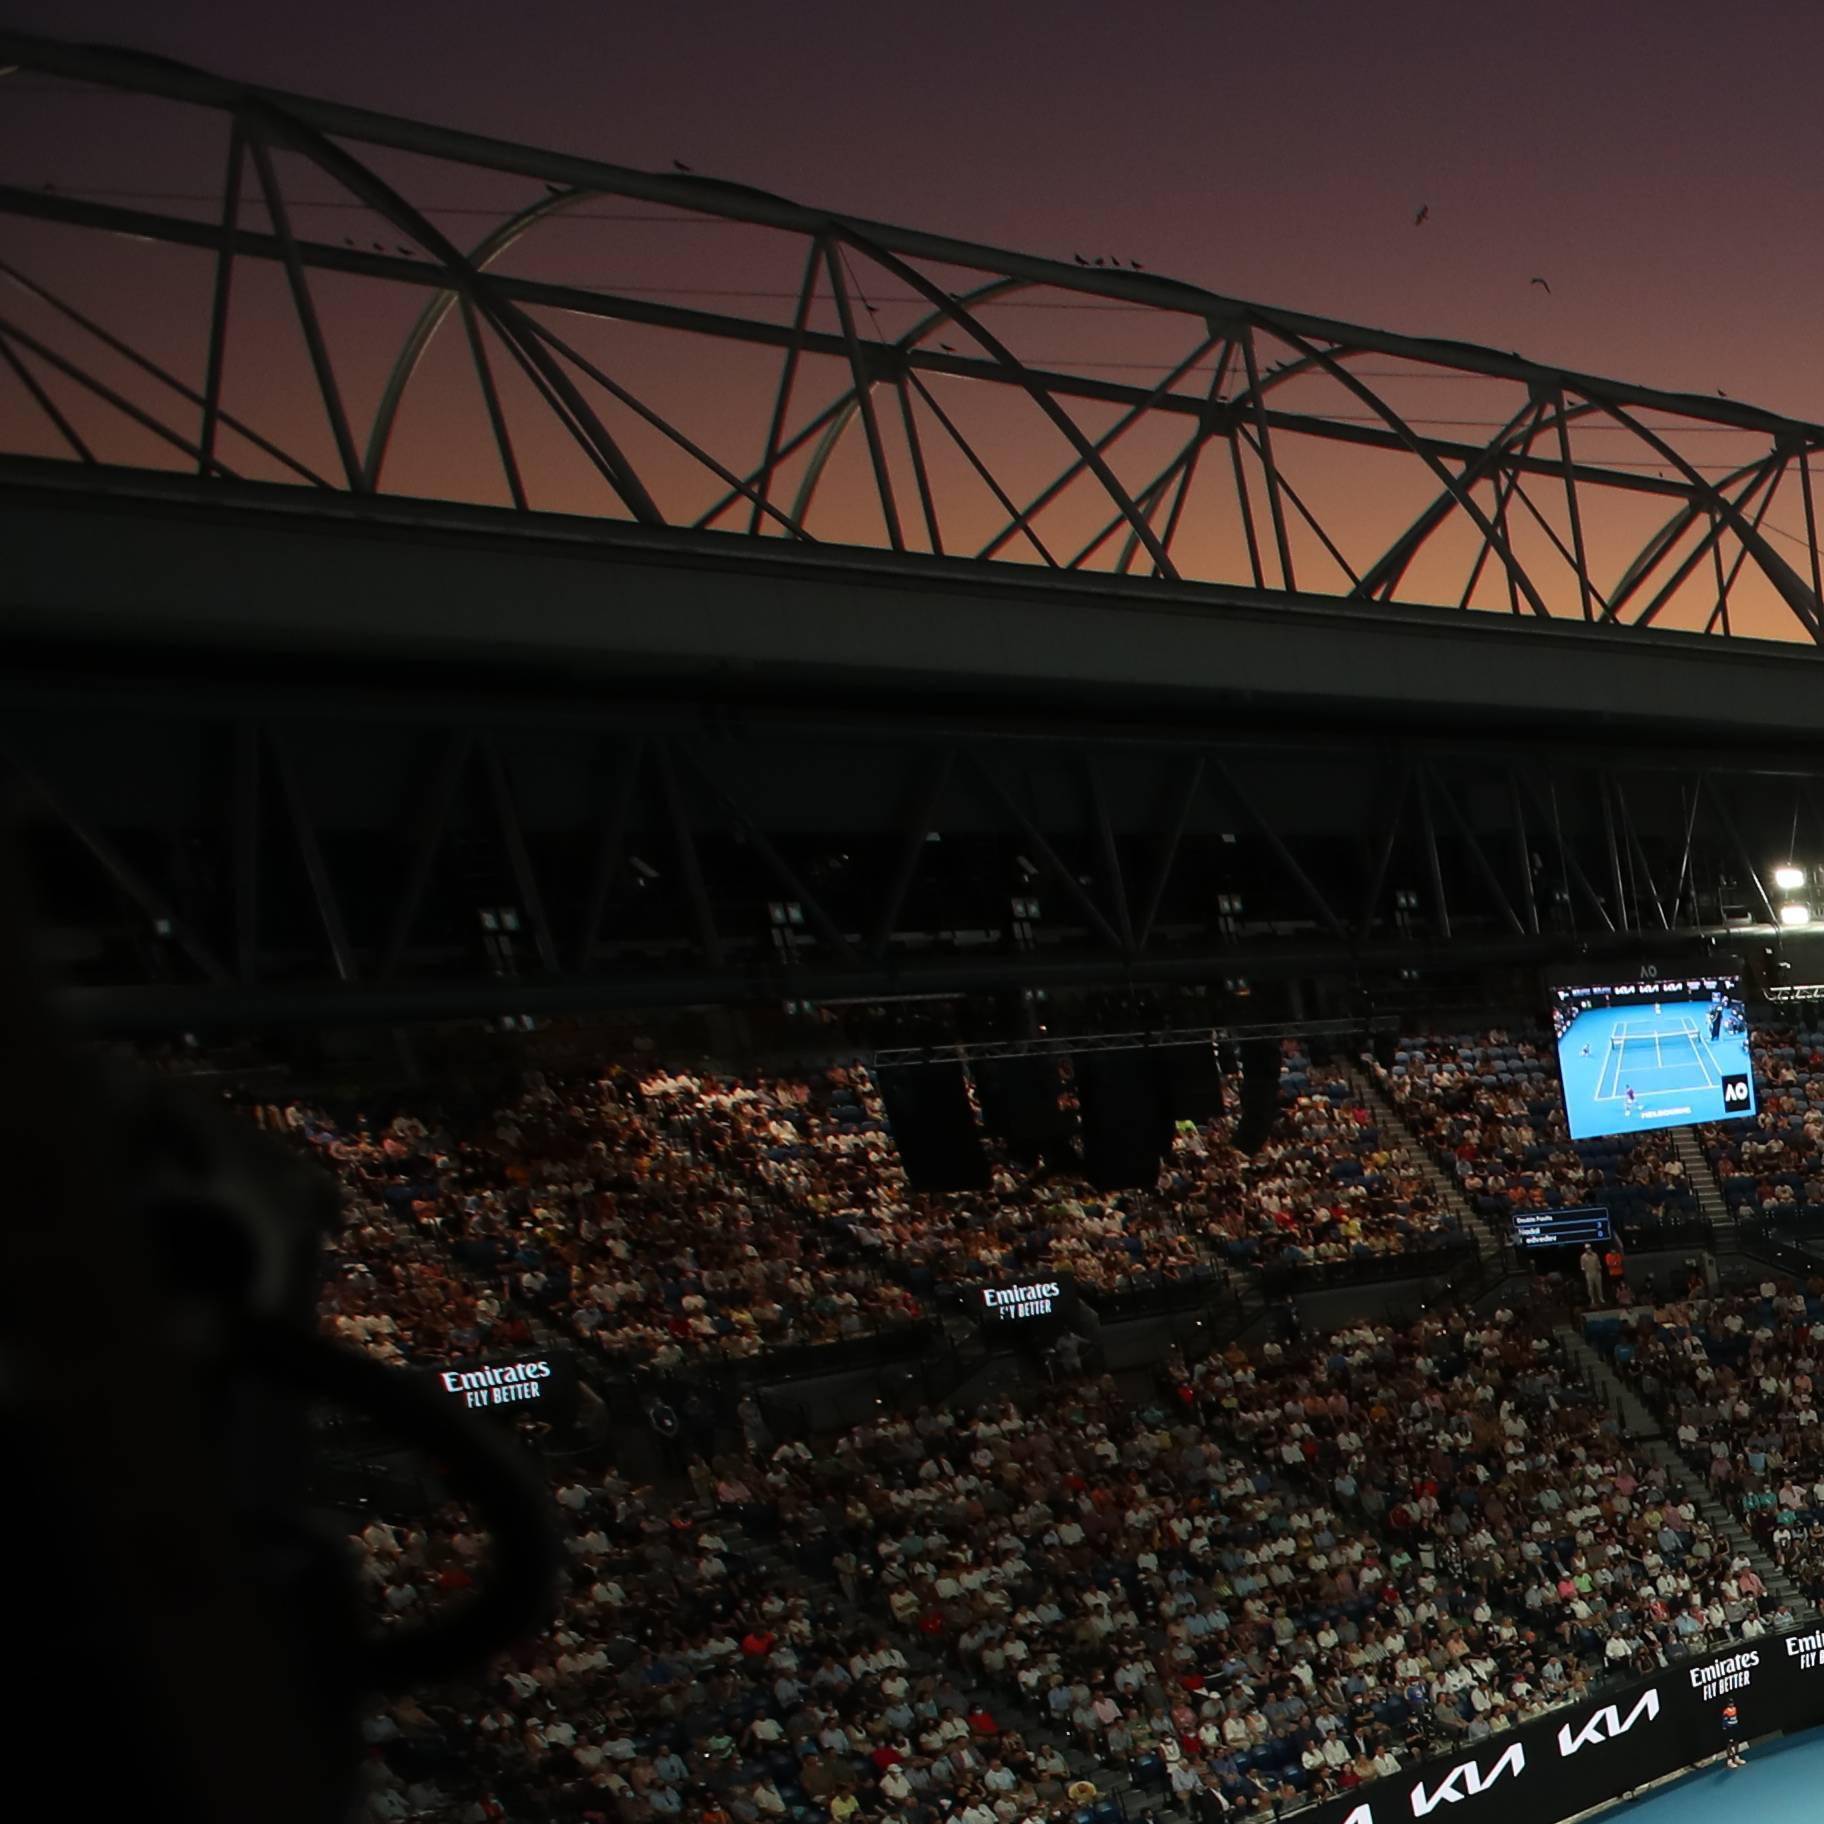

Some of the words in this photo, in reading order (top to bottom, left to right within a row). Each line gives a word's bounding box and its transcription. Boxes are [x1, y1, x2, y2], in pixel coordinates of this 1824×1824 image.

[983, 1278, 1060, 1308] Emirates
[1018, 1298, 1052, 1318] BETTER
[442, 1357, 551, 1395] Emirates
[466, 1389, 490, 1409] FLY
[493, 1380, 541, 1405] BETTER
[1690, 1650, 1759, 1687] Emirates
[1800, 1653, 1817, 1670] FLY
[1703, 1684, 1718, 1701] FLY
[1719, 1670, 1750, 1695] BETTER
